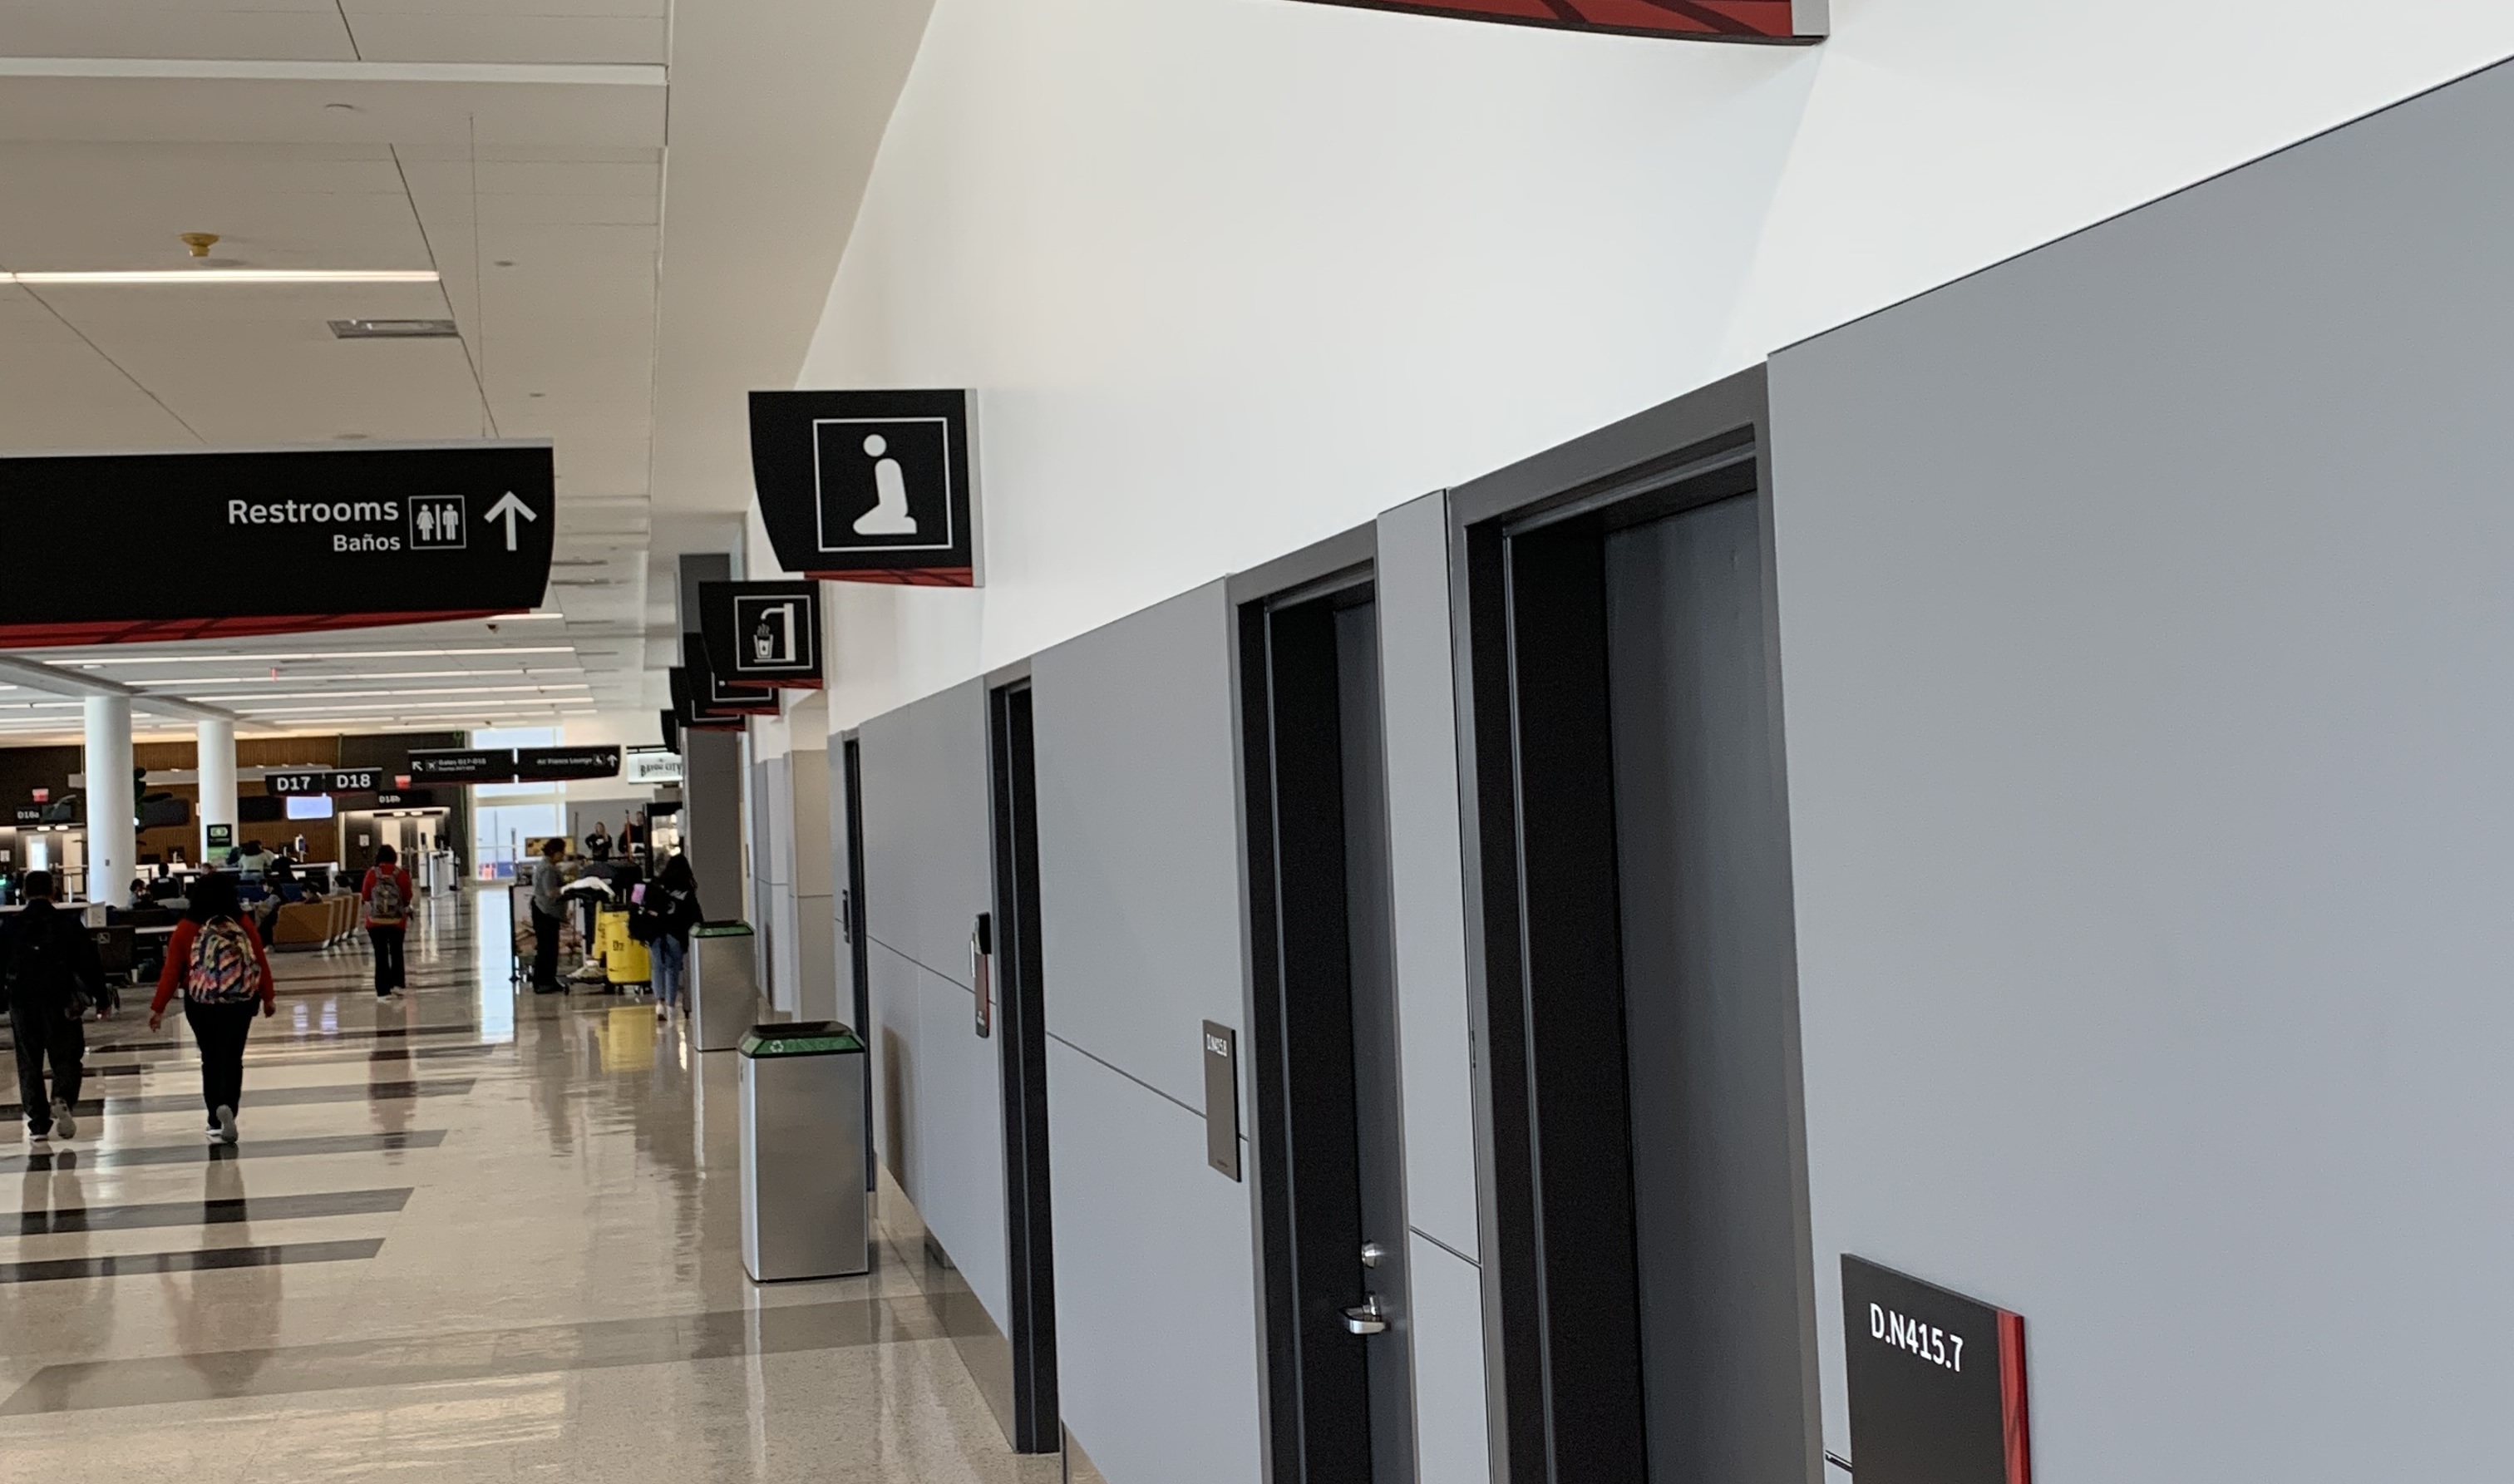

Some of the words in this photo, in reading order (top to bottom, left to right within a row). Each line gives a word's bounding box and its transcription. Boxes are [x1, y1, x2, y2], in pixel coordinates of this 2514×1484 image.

[228, 499, 399, 525] Restrooms
[333, 533, 401, 552] Baños
[277, 777, 312, 791] D17
[336, 774, 372, 789] D18
[1870, 1302, 1964, 1372] D.N415.7
